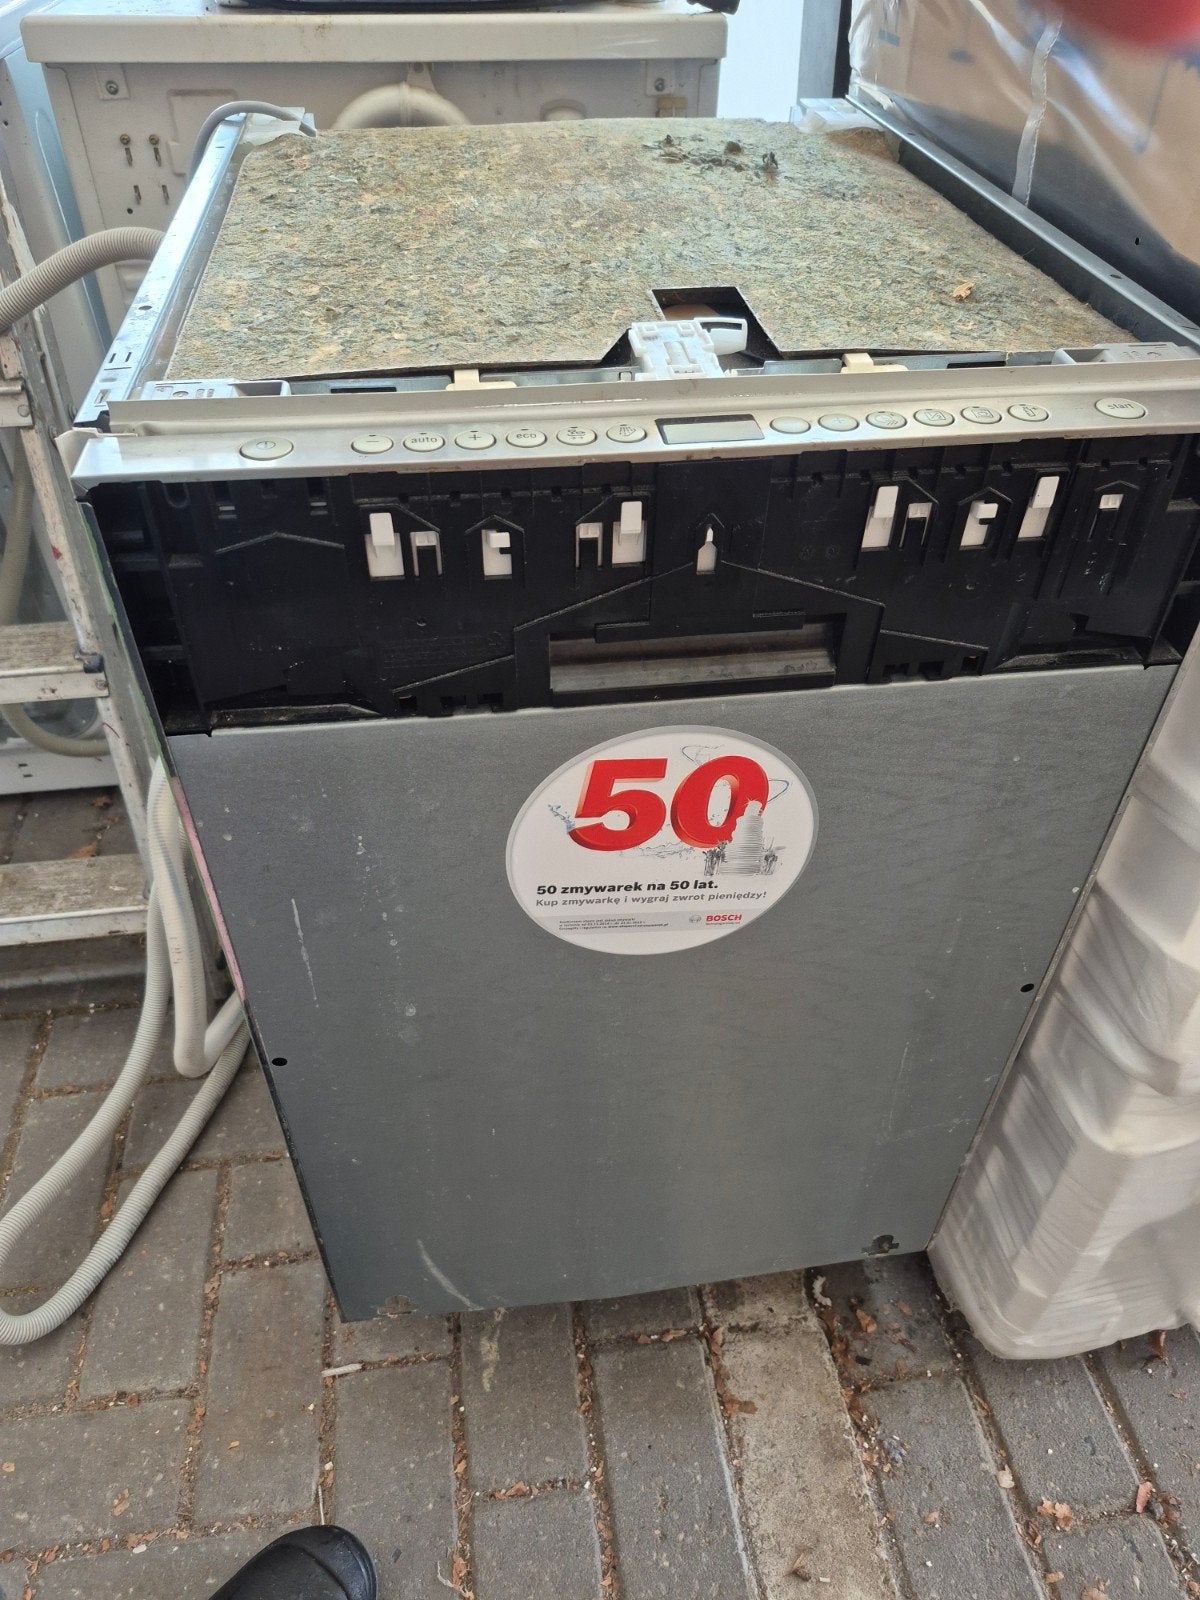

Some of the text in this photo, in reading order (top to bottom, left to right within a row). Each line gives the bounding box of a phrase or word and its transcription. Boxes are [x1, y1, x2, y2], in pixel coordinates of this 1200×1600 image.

[567, 755, 770, 852] 50
[537, 879, 719, 895] 50 zmywarek na 50 lat.
[536, 899, 558, 907] Kup
[561, 896, 621, 907] zmywarkę
[631, 894, 670, 904] wygraj
[672, 893, 705, 902] zwrot
[707, 891, 767, 902] pieniędzy!
[705, 914, 743, 922] BOSCH
